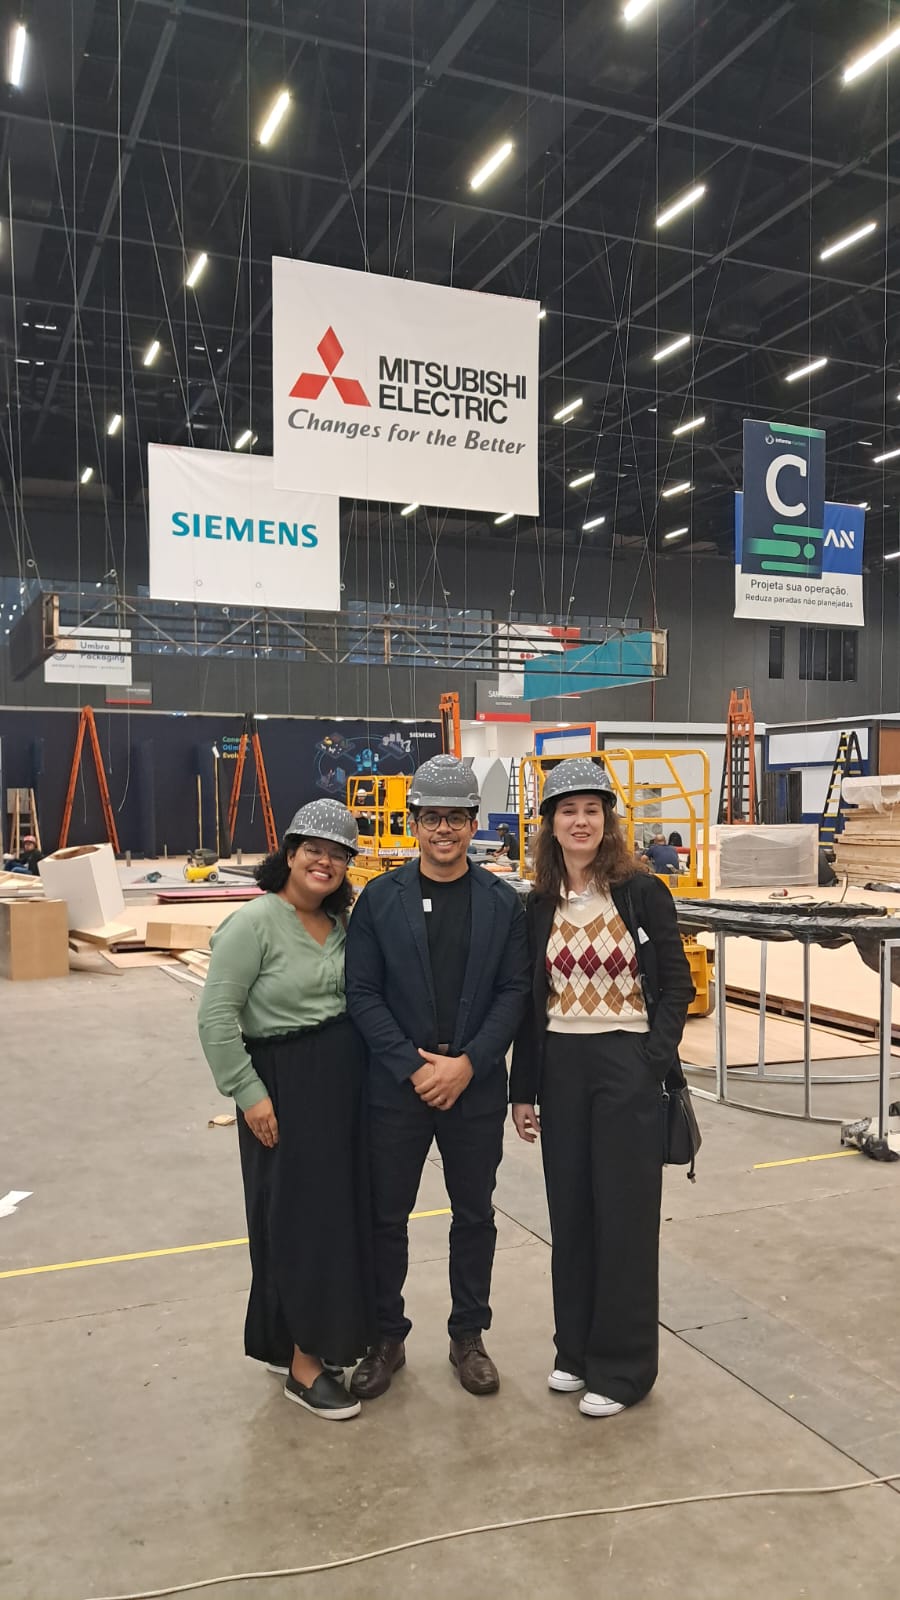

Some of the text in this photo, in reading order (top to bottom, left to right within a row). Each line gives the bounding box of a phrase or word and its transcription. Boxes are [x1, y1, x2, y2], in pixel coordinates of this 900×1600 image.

[379, 355, 527, 400] MITSUBISHI
[379, 384, 508, 425] ELECTRIC
[288, 408, 526, 455] Changes for the Better
[171, 511, 319, 548] SIEMENS
[745, 593, 772, 602] Reduza
[773, 595, 802, 604] paradas
[817, 599, 853, 608] planejadas
[750, 579, 849, 596] Projeta sua operação.
